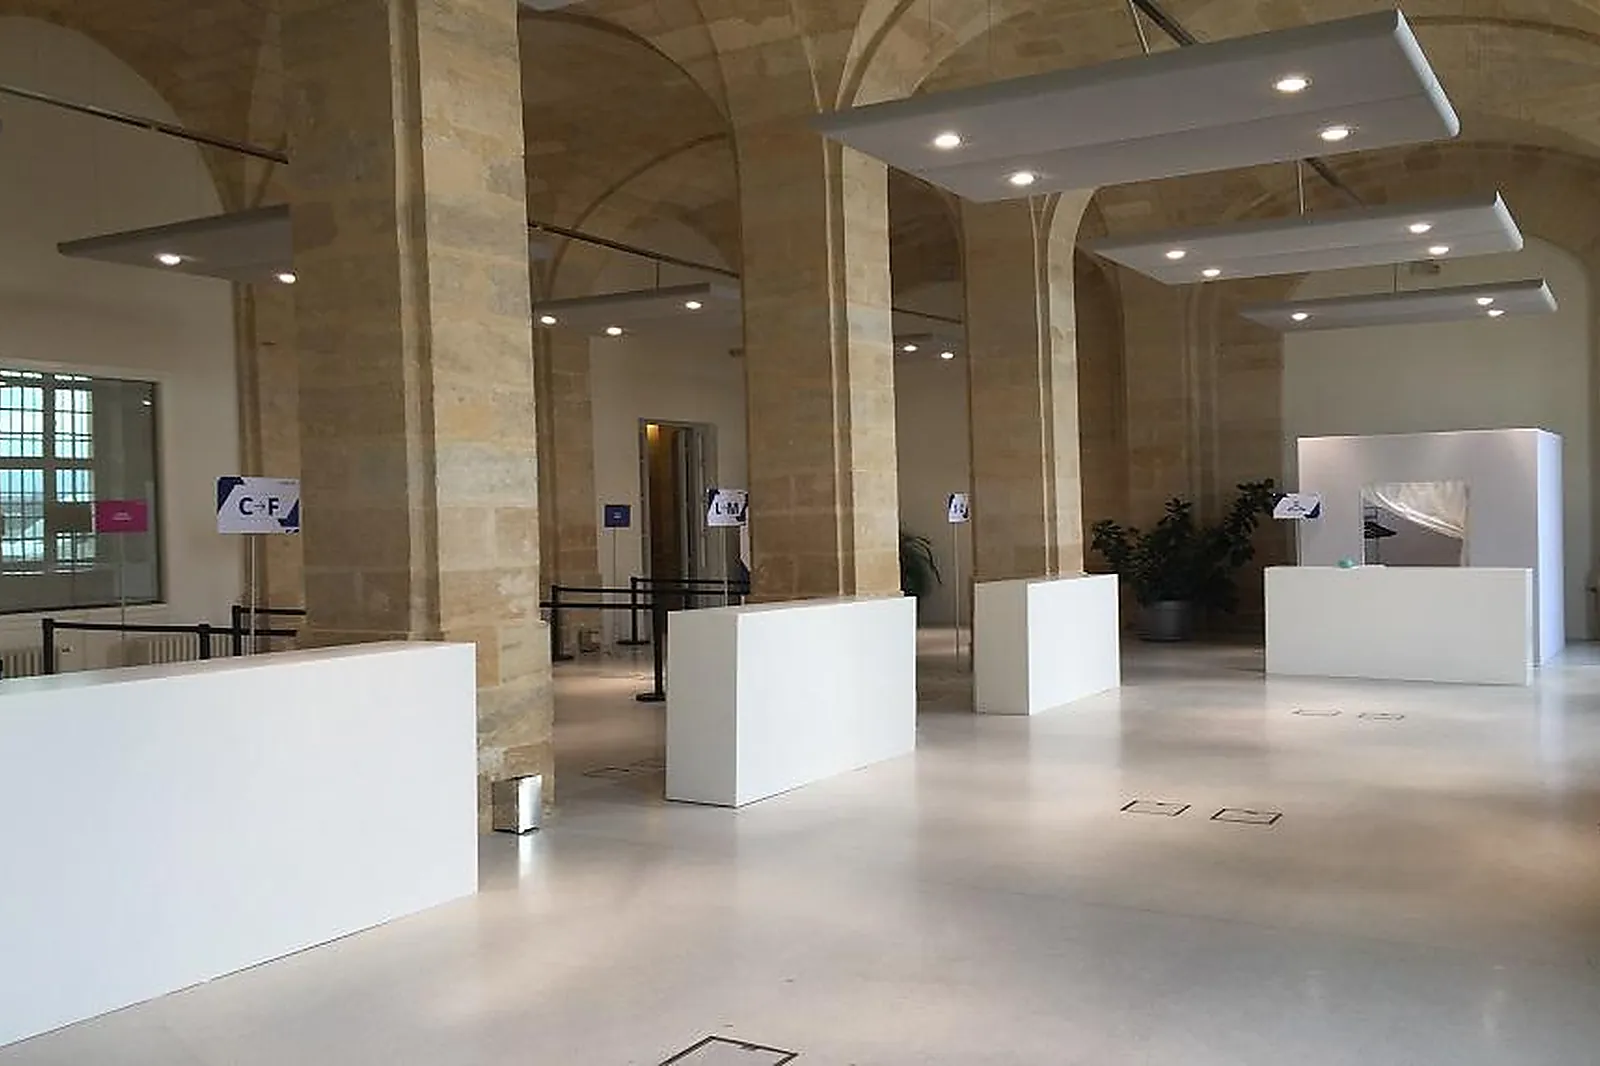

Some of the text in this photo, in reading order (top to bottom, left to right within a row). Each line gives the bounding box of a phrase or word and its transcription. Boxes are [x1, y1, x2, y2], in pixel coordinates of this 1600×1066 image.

[239, 497, 280, 516] C F
[715, 503, 721, 515] L
